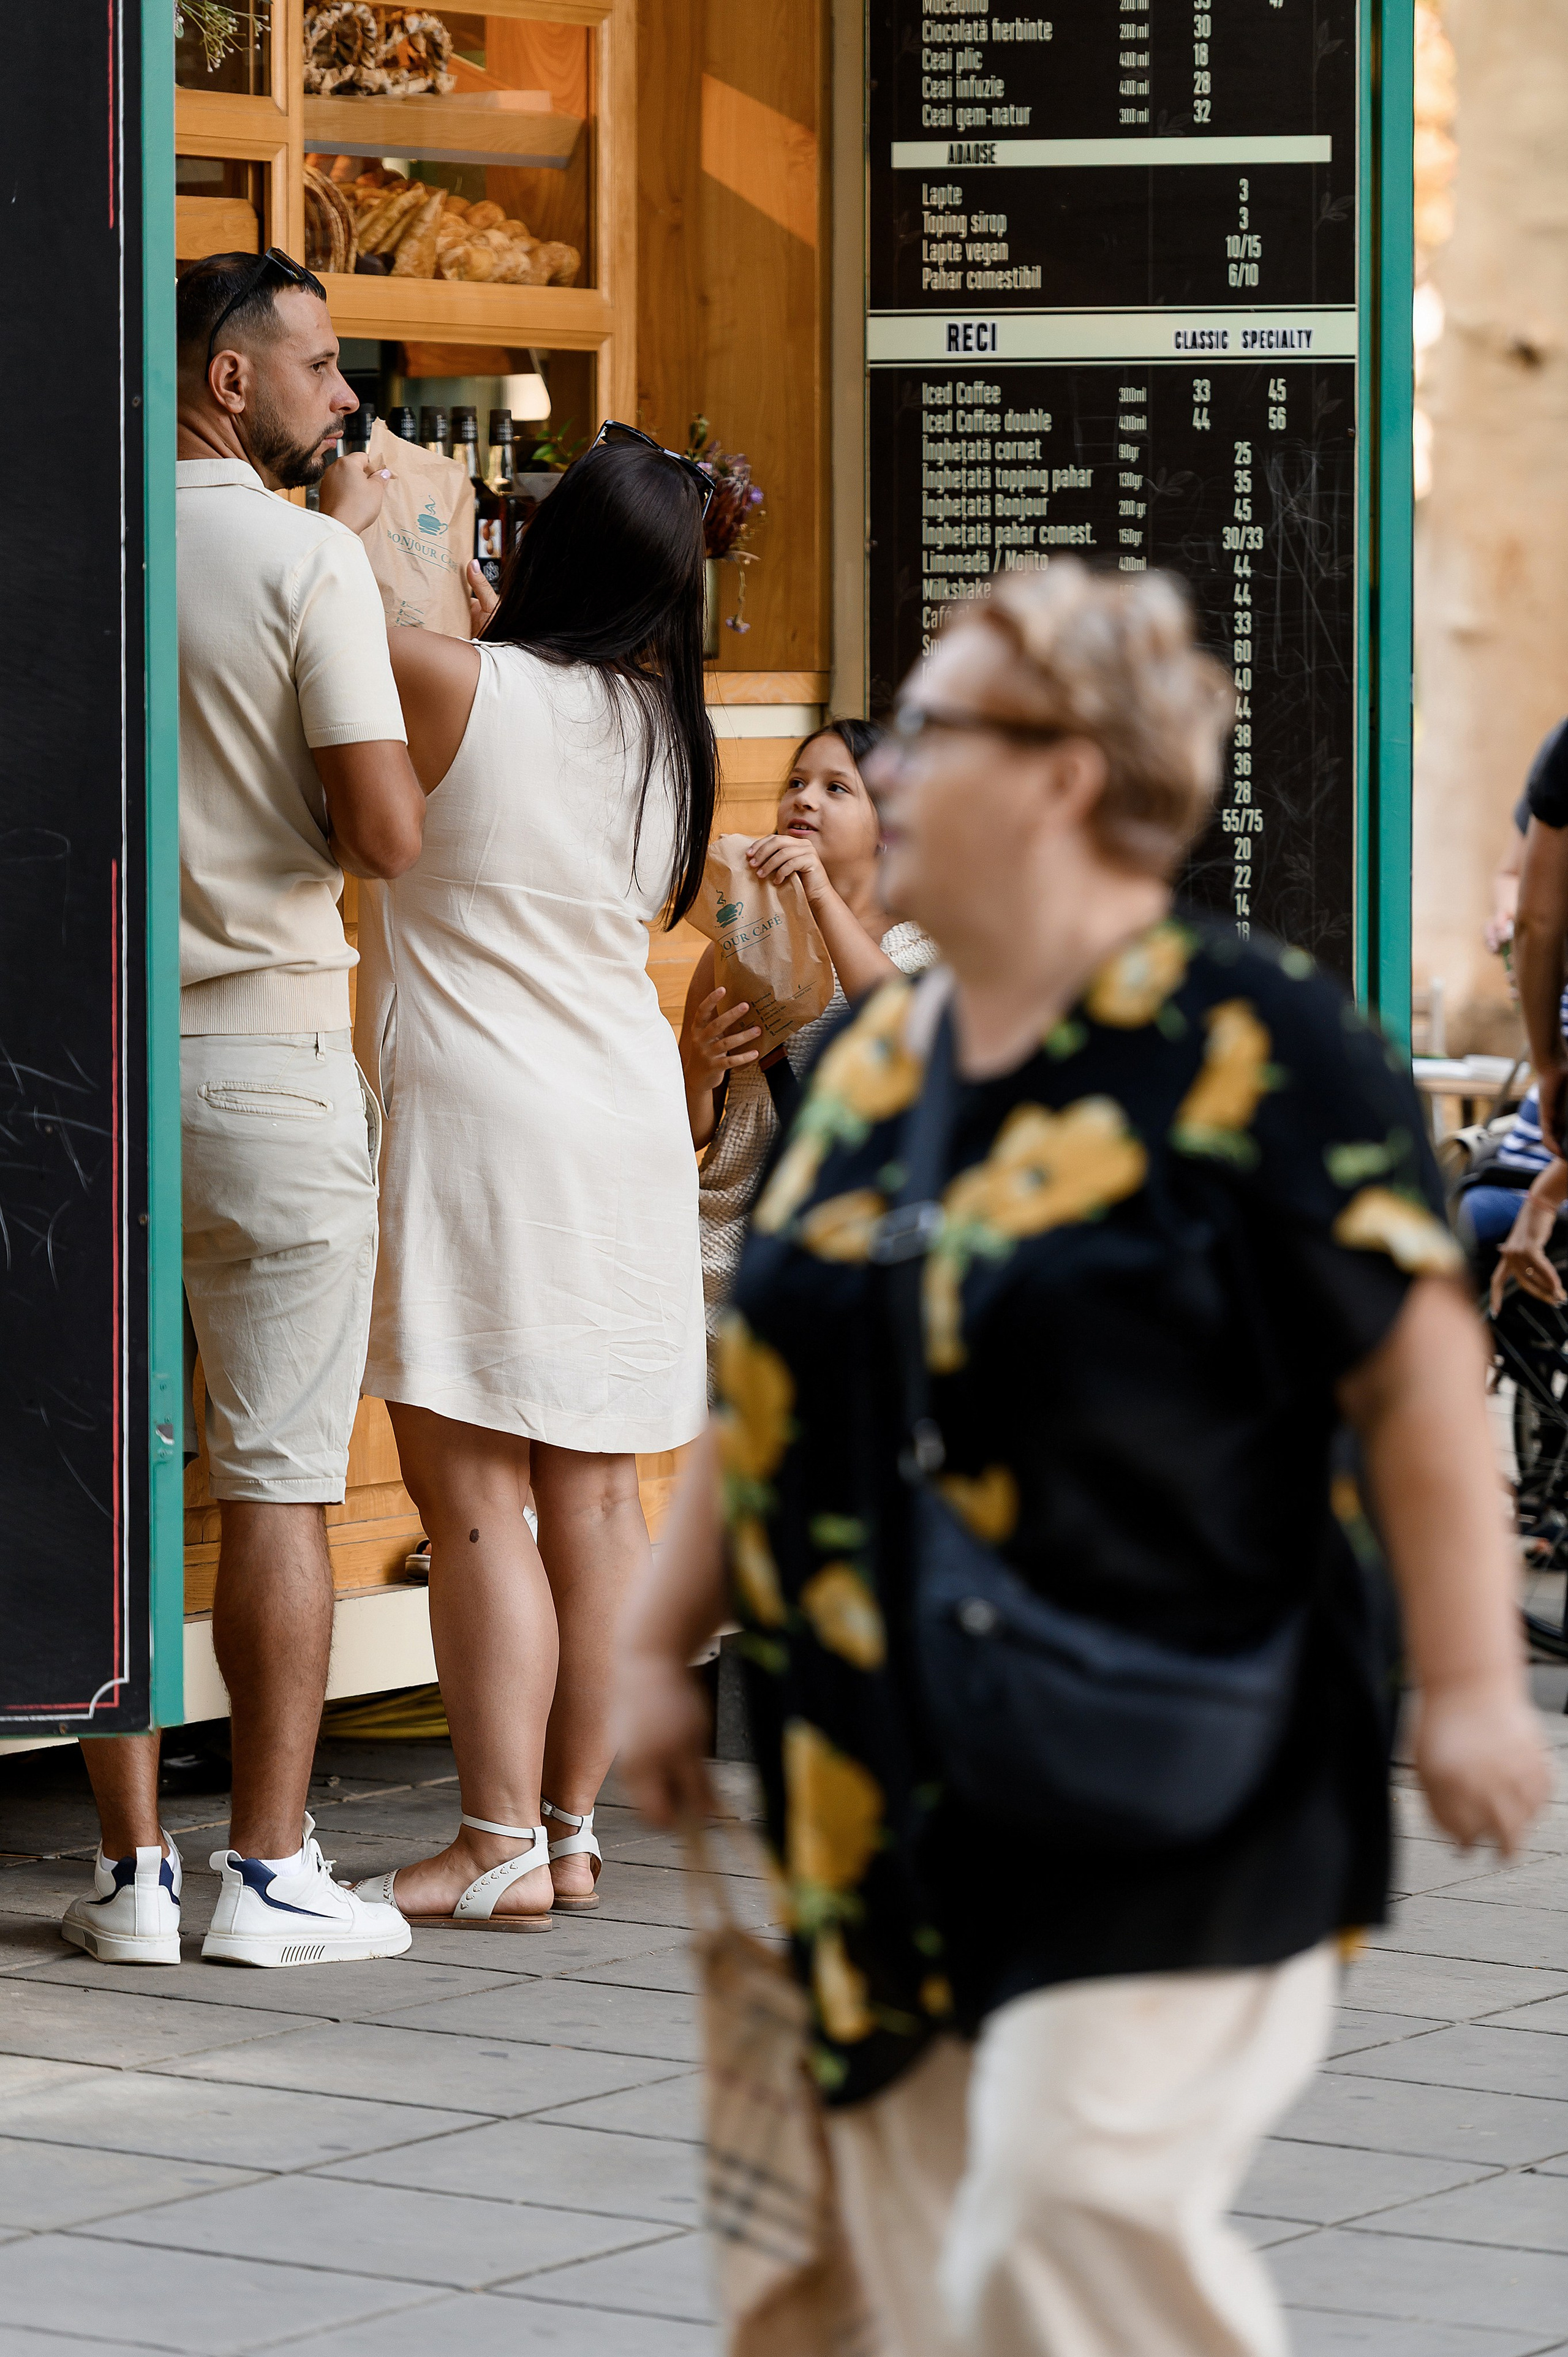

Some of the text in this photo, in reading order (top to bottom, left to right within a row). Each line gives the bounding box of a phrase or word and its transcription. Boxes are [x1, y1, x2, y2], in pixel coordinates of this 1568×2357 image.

[1120, 24, 1136, 39] 200
[1137, 23, 1149, 38] ml
[1194, 14, 1211, 38] 30
[922, 43, 1208, 74] Ceai plic 400 ml 18
[922, 71, 1211, 99] Ceai infuzie 400 ml 28
[922, 104, 952, 127] Ceai
[1120, 108, 1136, 124] 300
[1137, 108, 1149, 123] ml
[1194, 99, 1211, 123] 32
[948, 143, 997, 164] ADAOSE
[922, 178, 1248, 209] Lapte 3
[922, 206, 1248, 238] Toping sirop 3
[922, 234, 1261, 266] Lapte vegan 10/15
[922, 262, 1259, 290] Pahar comestibil 6/10
[947, 323, 1313, 351] RECI CLASSIC SPECIALTY
[922, 382, 952, 404] Iced
[956, 381, 1001, 404] Coffee
[1193, 379, 1210, 402] 33
[1268, 379, 1286, 401] 45
[923, 410, 952, 432] Iced
[957, 409, 1001, 432] Coffee
[1005, 409, 1052, 432] double
[1193, 407, 1210, 430] 44
[1268, 407, 1286, 430] 56
[995, 439, 1042, 460] cornet
[1234, 442, 1251, 465] 25
[995, 466, 1048, 493] topping
[1052, 464, 1093, 492] pahar
[1234, 470, 1251, 493] 35
[995, 494, 1049, 521] Bonjour
[1234, 499, 1251, 521] 45
[387, 529, 437, 559] BONJOUR
[995, 521, 1036, 548] pahar
[1039, 522, 1096, 544] comest.
[1223, 526, 1263, 550] 30/33
[922, 550, 990, 573] Limonadă
[993, 548, 1001, 573] /
[1005, 550, 1049, 575] Mojito
[1234, 555, 1252, 578] 44
[922, 578, 1252, 606] Milkshake 44
[1234, 611, 1251, 634] 33
[1234, 639, 1251, 663] 60
[1234, 668, 1251, 691] 40
[1234, 696, 1251, 719] 44
[1234, 725, 1251, 747] 38
[1234, 752, 1251, 775] 36
[1234, 781, 1251, 804] 28
[1223, 808, 1263, 832] 55/75
[1234, 837, 1251, 860] 20
[1234, 865, 1251, 888] 22
[1235, 894, 1250, 916] 14
[753, 914, 783, 937] CAFÉ
[1235, 921, 1250, 941] 18
